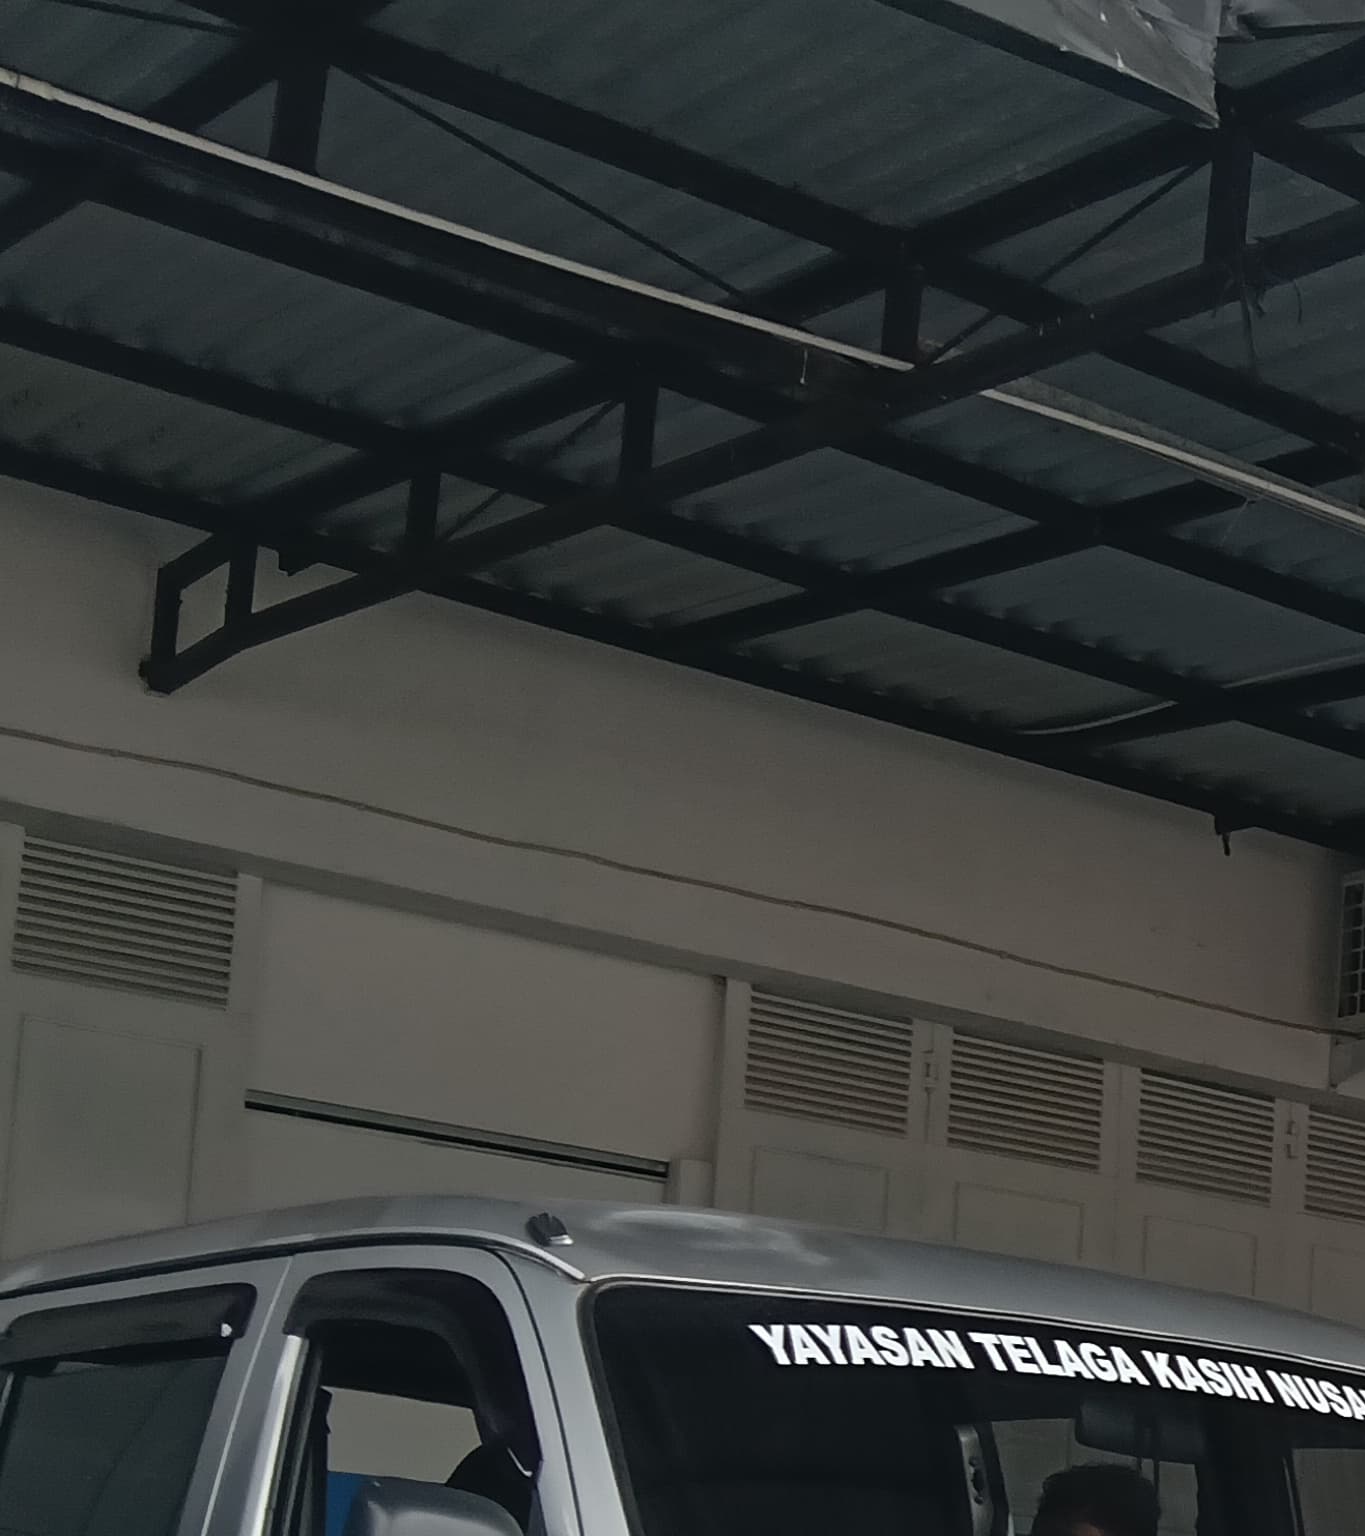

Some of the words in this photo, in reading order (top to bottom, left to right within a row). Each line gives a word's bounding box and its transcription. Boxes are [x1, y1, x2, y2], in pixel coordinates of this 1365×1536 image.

[748, 1324, 975, 1371] YAYASAN
[968, 1332, 1147, 1386] TELAGA
[1141, 1350, 1273, 1405] KASIH
